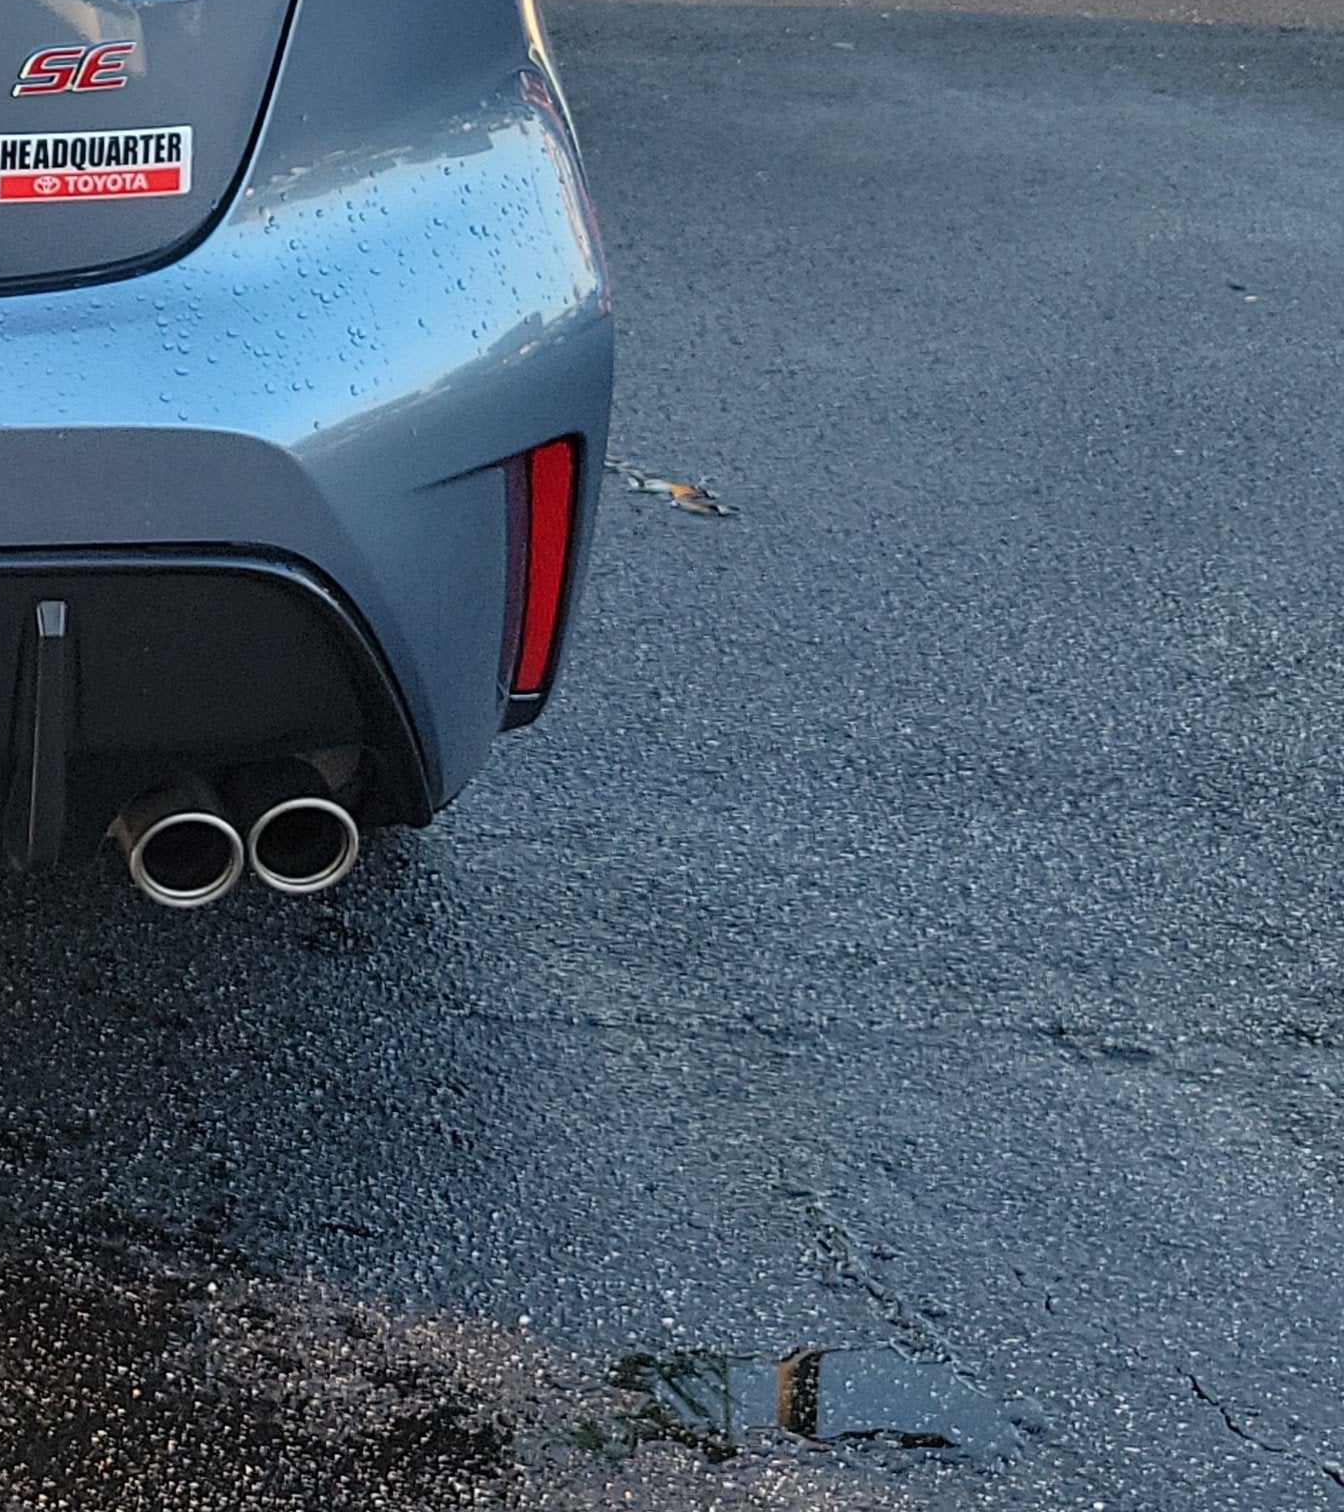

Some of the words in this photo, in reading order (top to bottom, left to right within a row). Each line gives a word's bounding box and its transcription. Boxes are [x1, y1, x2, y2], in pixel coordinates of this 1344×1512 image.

[11, 41, 138, 97] SE
[0, 132, 182, 171] HEADQUARTER
[64, 172, 148, 194] TOYOTA
